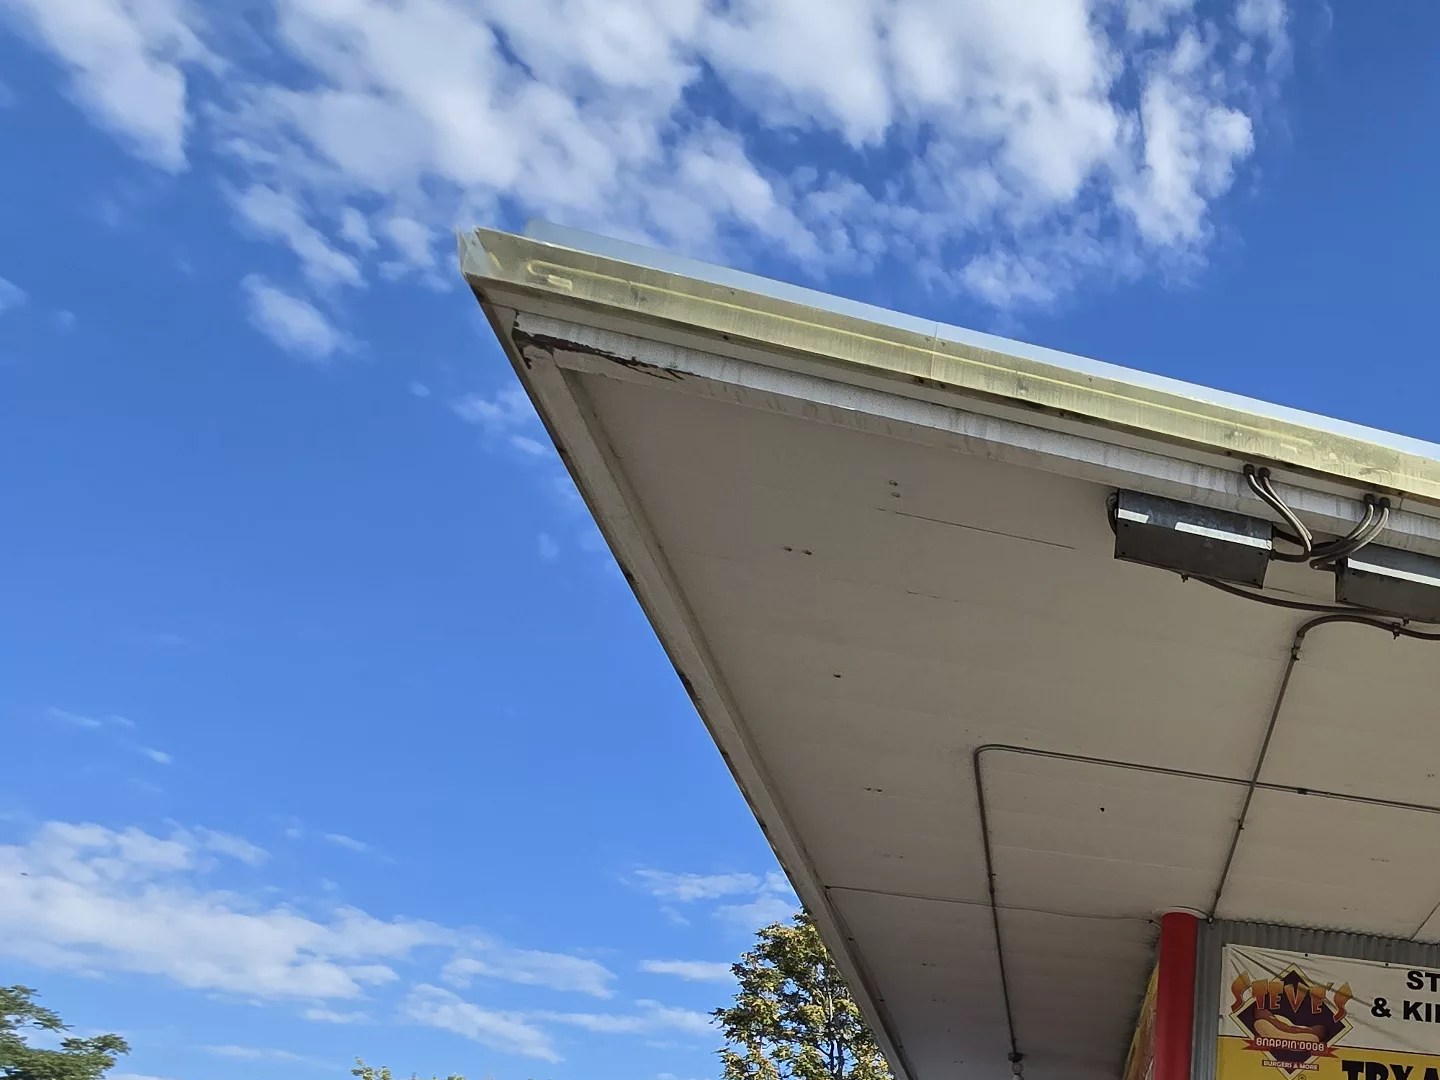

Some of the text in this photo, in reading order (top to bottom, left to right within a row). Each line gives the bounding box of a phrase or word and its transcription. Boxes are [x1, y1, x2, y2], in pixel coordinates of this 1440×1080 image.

[1231, 970, 1353, 1023] STEVE'S
[1371, 997, 1391, 1018] &
[1263, 1060, 1292, 1069] BURGERS
